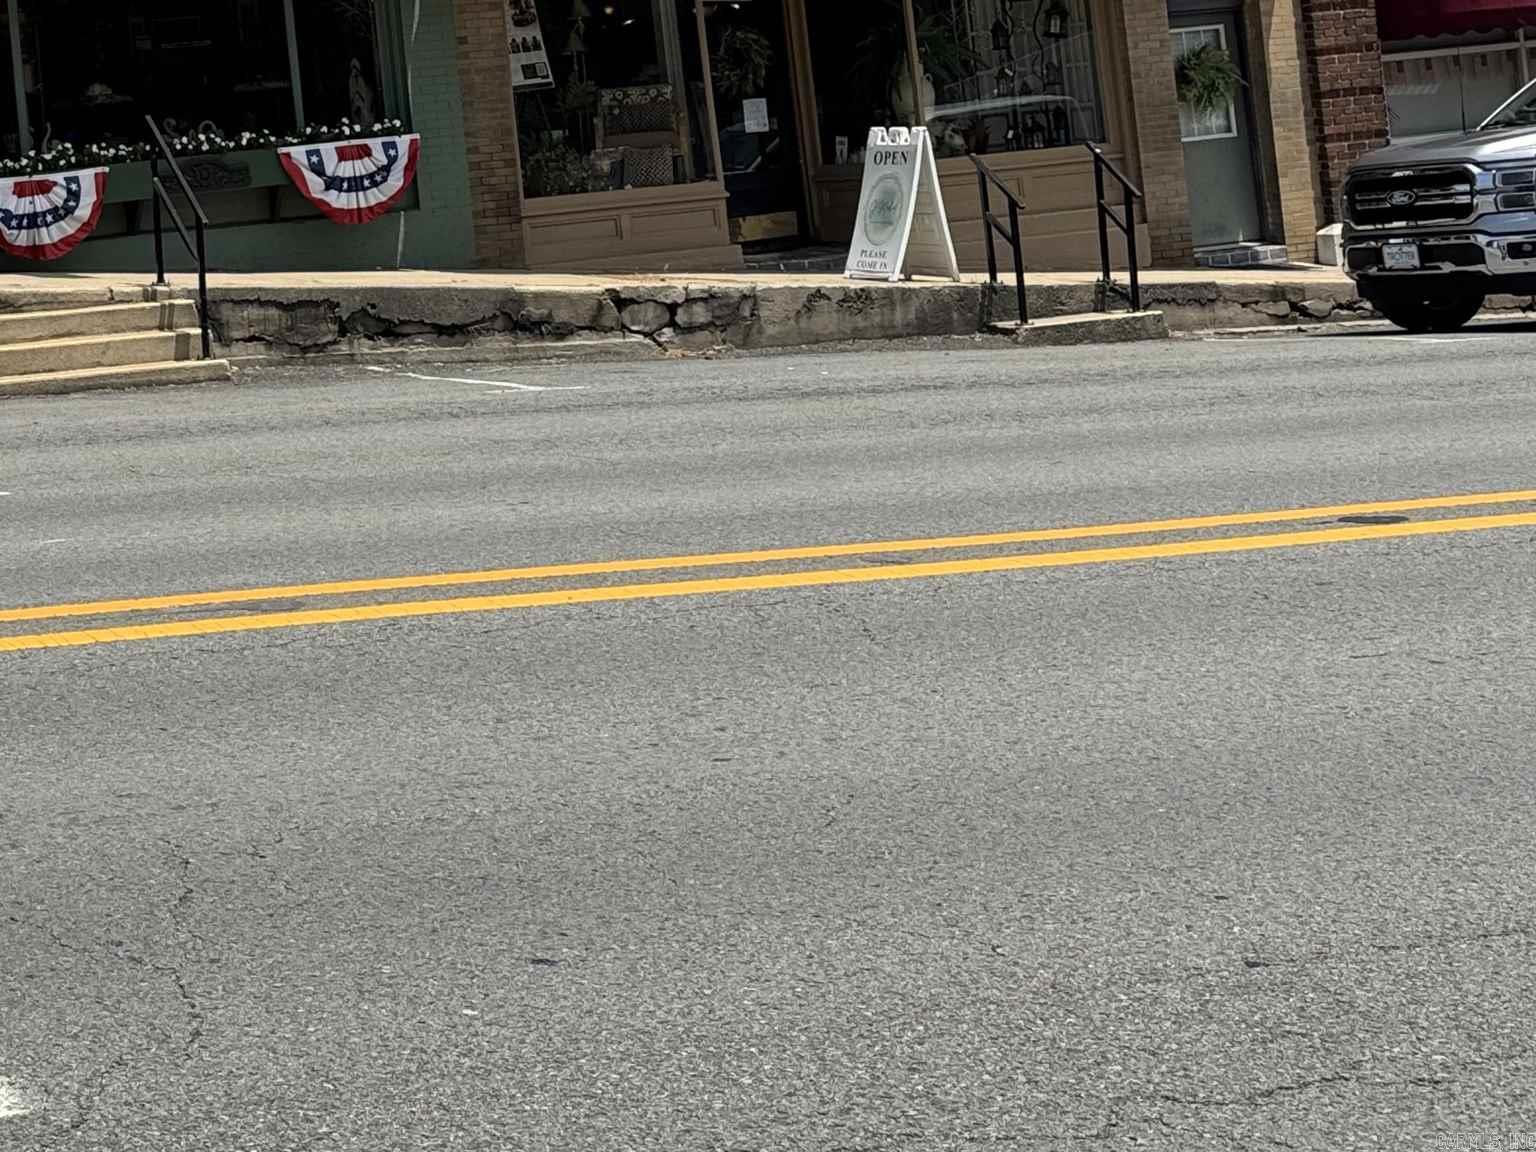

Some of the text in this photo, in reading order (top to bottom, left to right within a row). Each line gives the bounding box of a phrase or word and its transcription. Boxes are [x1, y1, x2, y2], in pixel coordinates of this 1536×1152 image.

[873, 151, 909, 166] OPEN
[860, 249, 888, 258] PLEASE
[856, 260, 876, 269] COME
